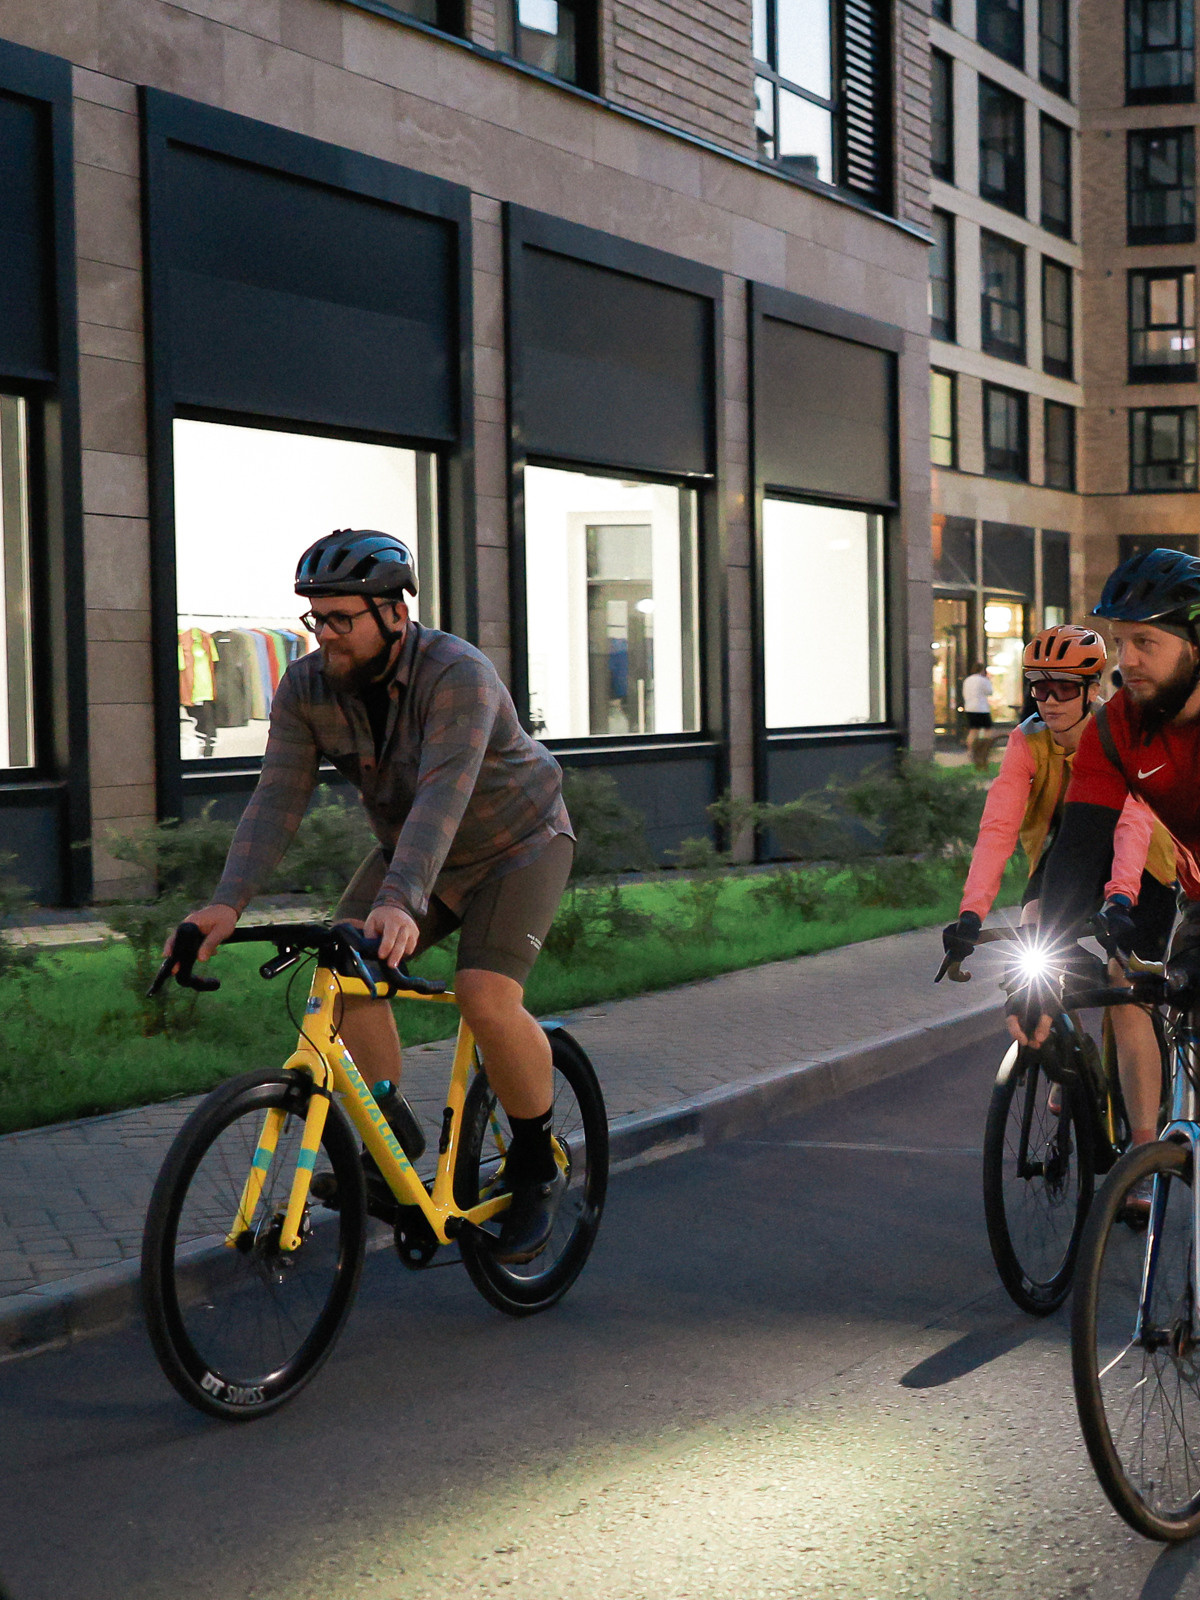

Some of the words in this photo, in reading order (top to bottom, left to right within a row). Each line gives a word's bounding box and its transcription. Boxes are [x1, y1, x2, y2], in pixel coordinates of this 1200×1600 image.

[338, 1057, 382, 1123] SANTA
[377, 1121, 412, 1173] CRUZ
[201, 1371, 225, 1396] DT
[225, 1385, 265, 1405] SWISS
